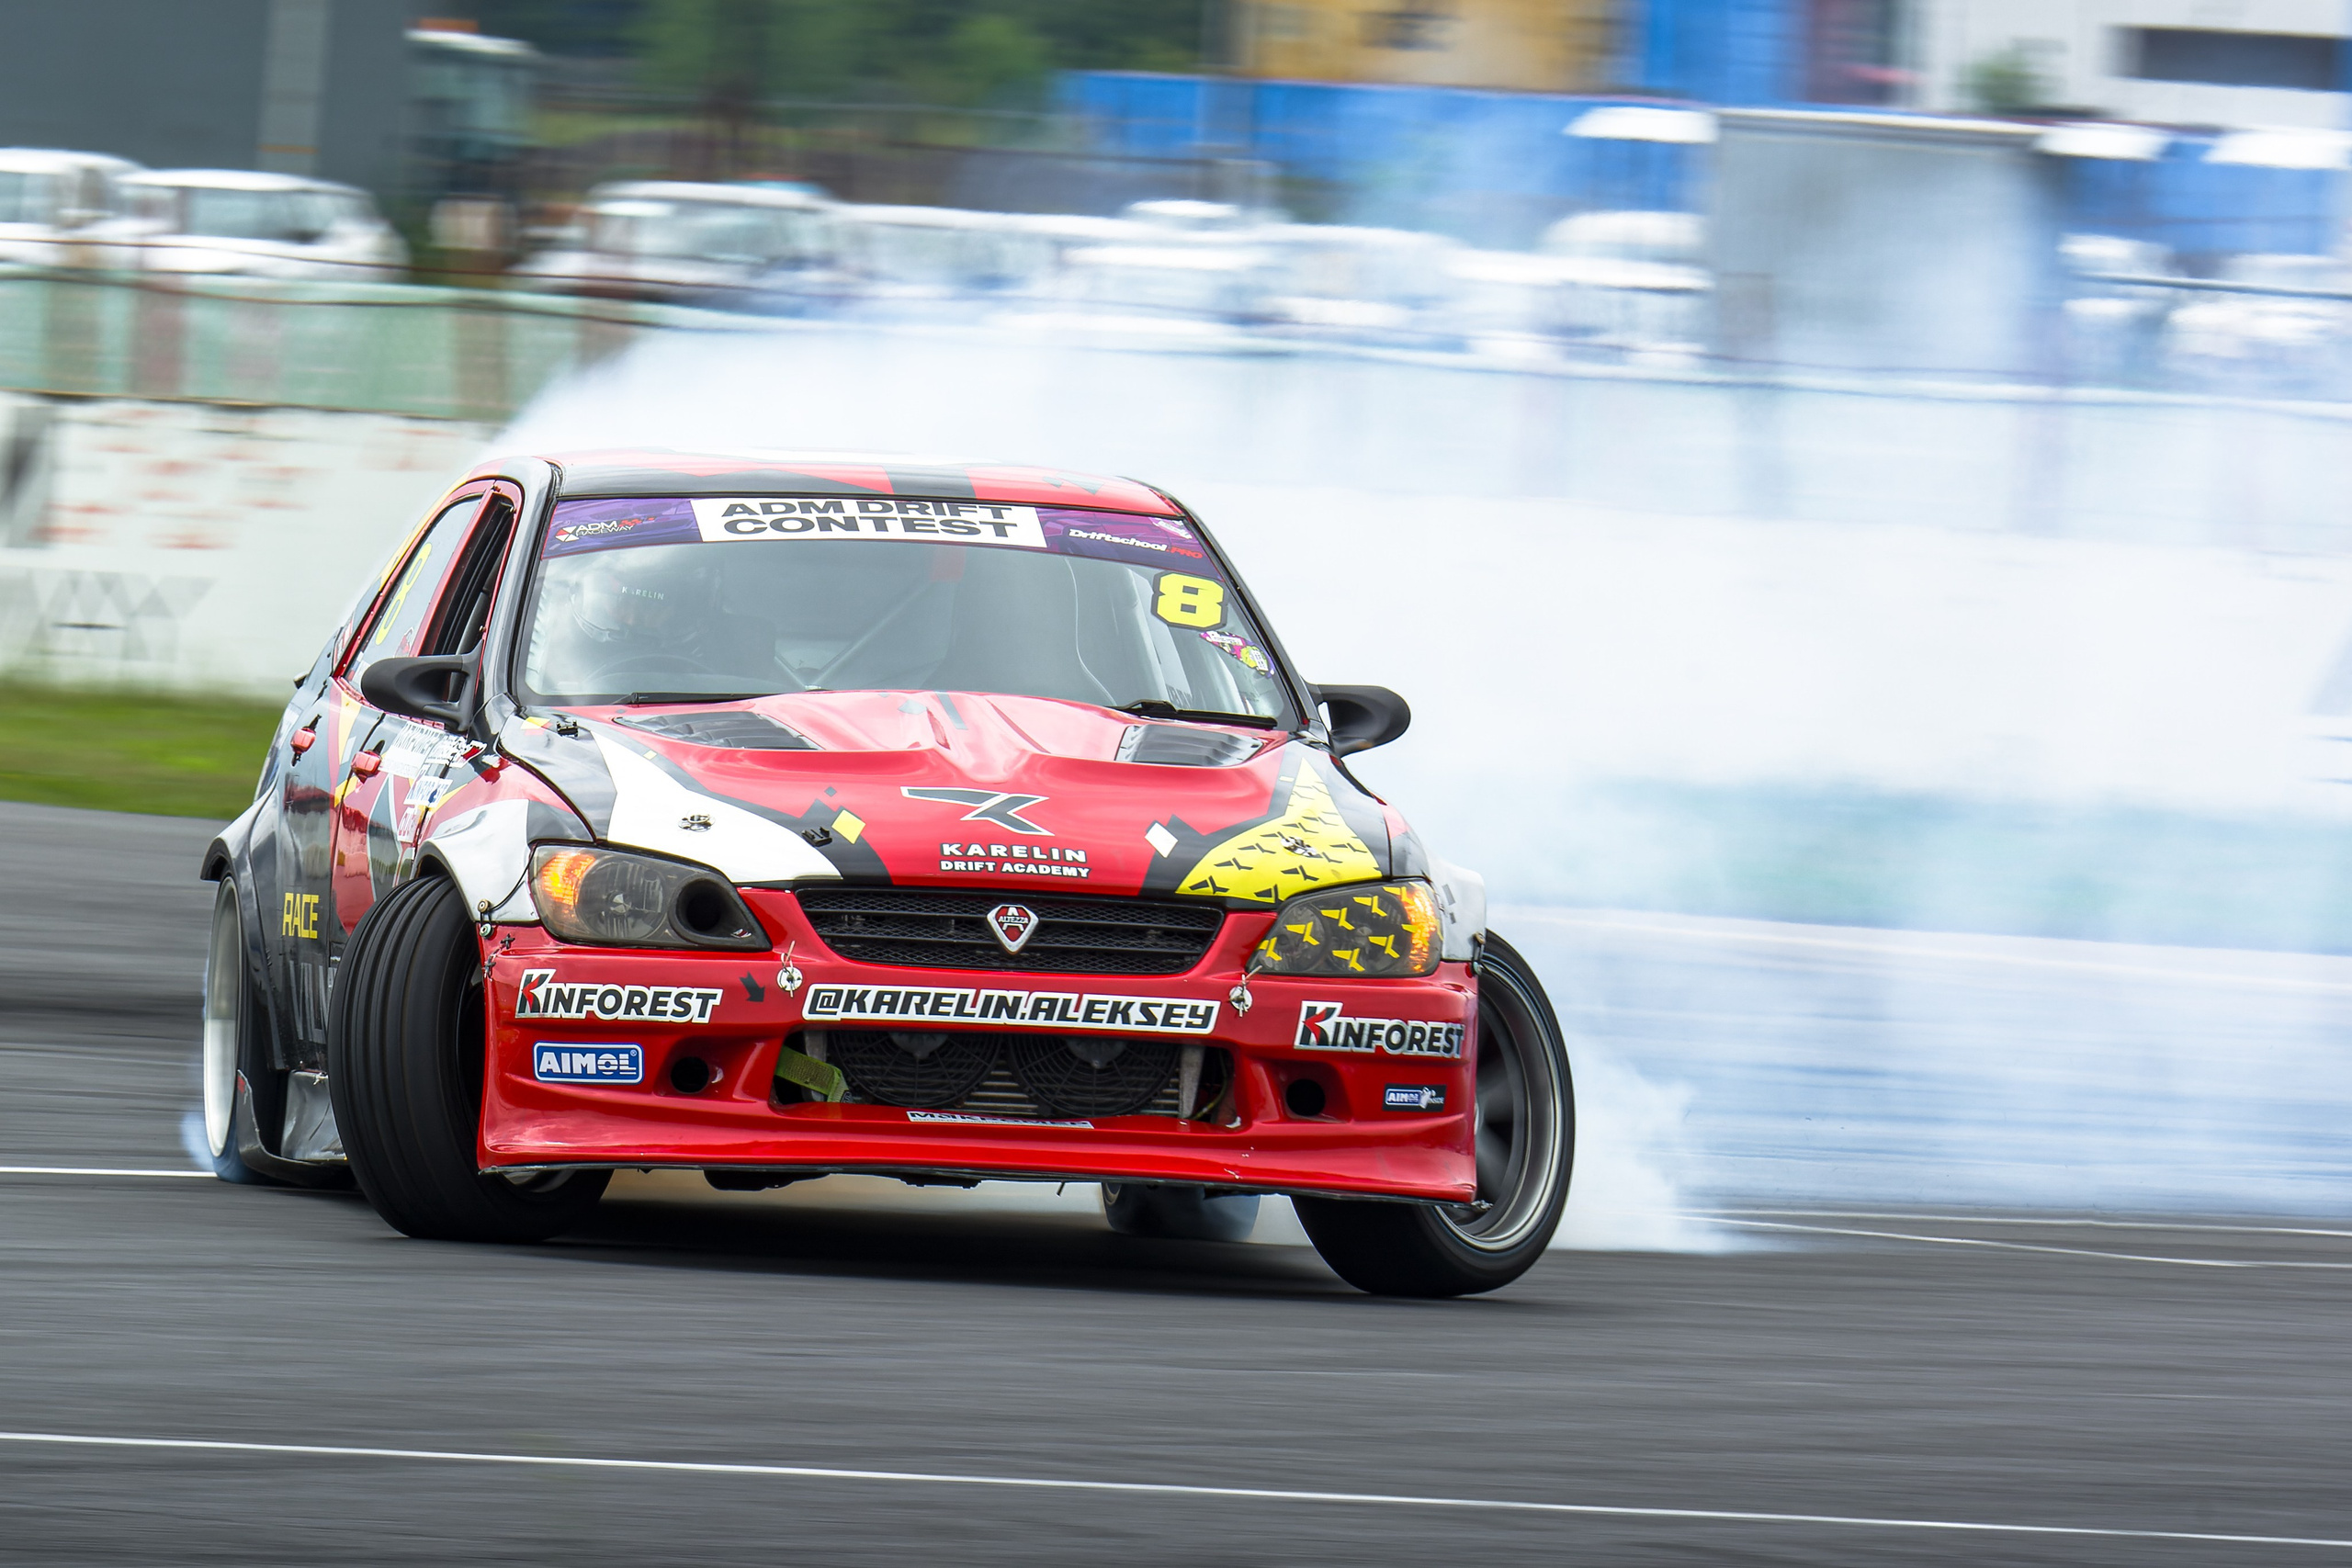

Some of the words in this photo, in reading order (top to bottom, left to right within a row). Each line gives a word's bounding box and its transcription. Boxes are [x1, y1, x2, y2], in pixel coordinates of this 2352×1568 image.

[577, 520, 618, 531] ADM
[721, 501, 846, 517] ADM
[856, 501, 1012, 520] DRIFT
[724, 516, 1018, 537] CONTEST
[374, 541, 433, 646] 8
[621, 586, 665, 601] KRELIN
[1155, 571, 1227, 629] 8
[939, 860, 997, 872] DRIFT
[1001, 862, 1091, 878] ACADEMY
[941, 843, 1088, 863] KARELIN
[282, 892, 320, 940] RACE
[517, 973, 718, 1019] KINFOREST
[809, 987, 1215, 1030] @KARELIN.ALEKSEY
[1298, 1005, 1464, 1055] KINFOREST
